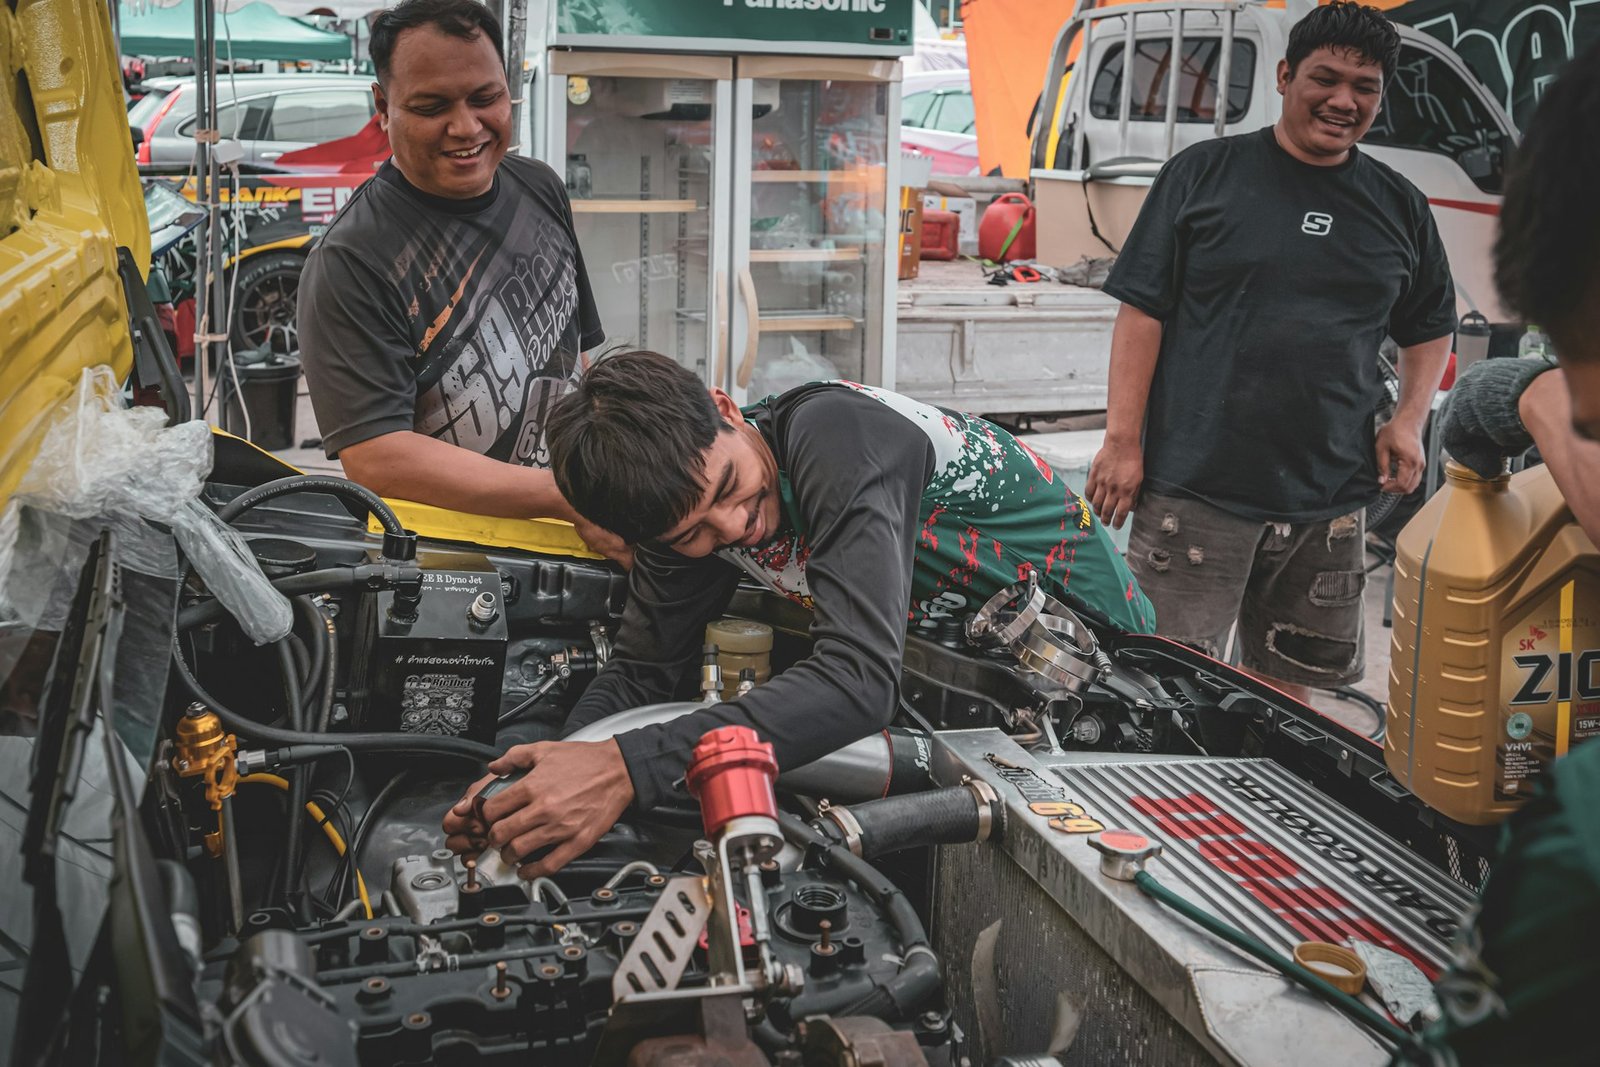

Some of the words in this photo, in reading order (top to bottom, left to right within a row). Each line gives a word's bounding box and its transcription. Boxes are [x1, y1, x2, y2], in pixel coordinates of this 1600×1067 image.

[722, 0, 886, 13] anasonic
[900, 208, 915, 233] IC
[1301, 211, 1333, 236] S
[445, 574, 467, 585] Dyno
[469, 575, 482, 584] Jet
[1519, 639, 1535, 650] SK
[1579, 720, 1600, 729] 15W-
